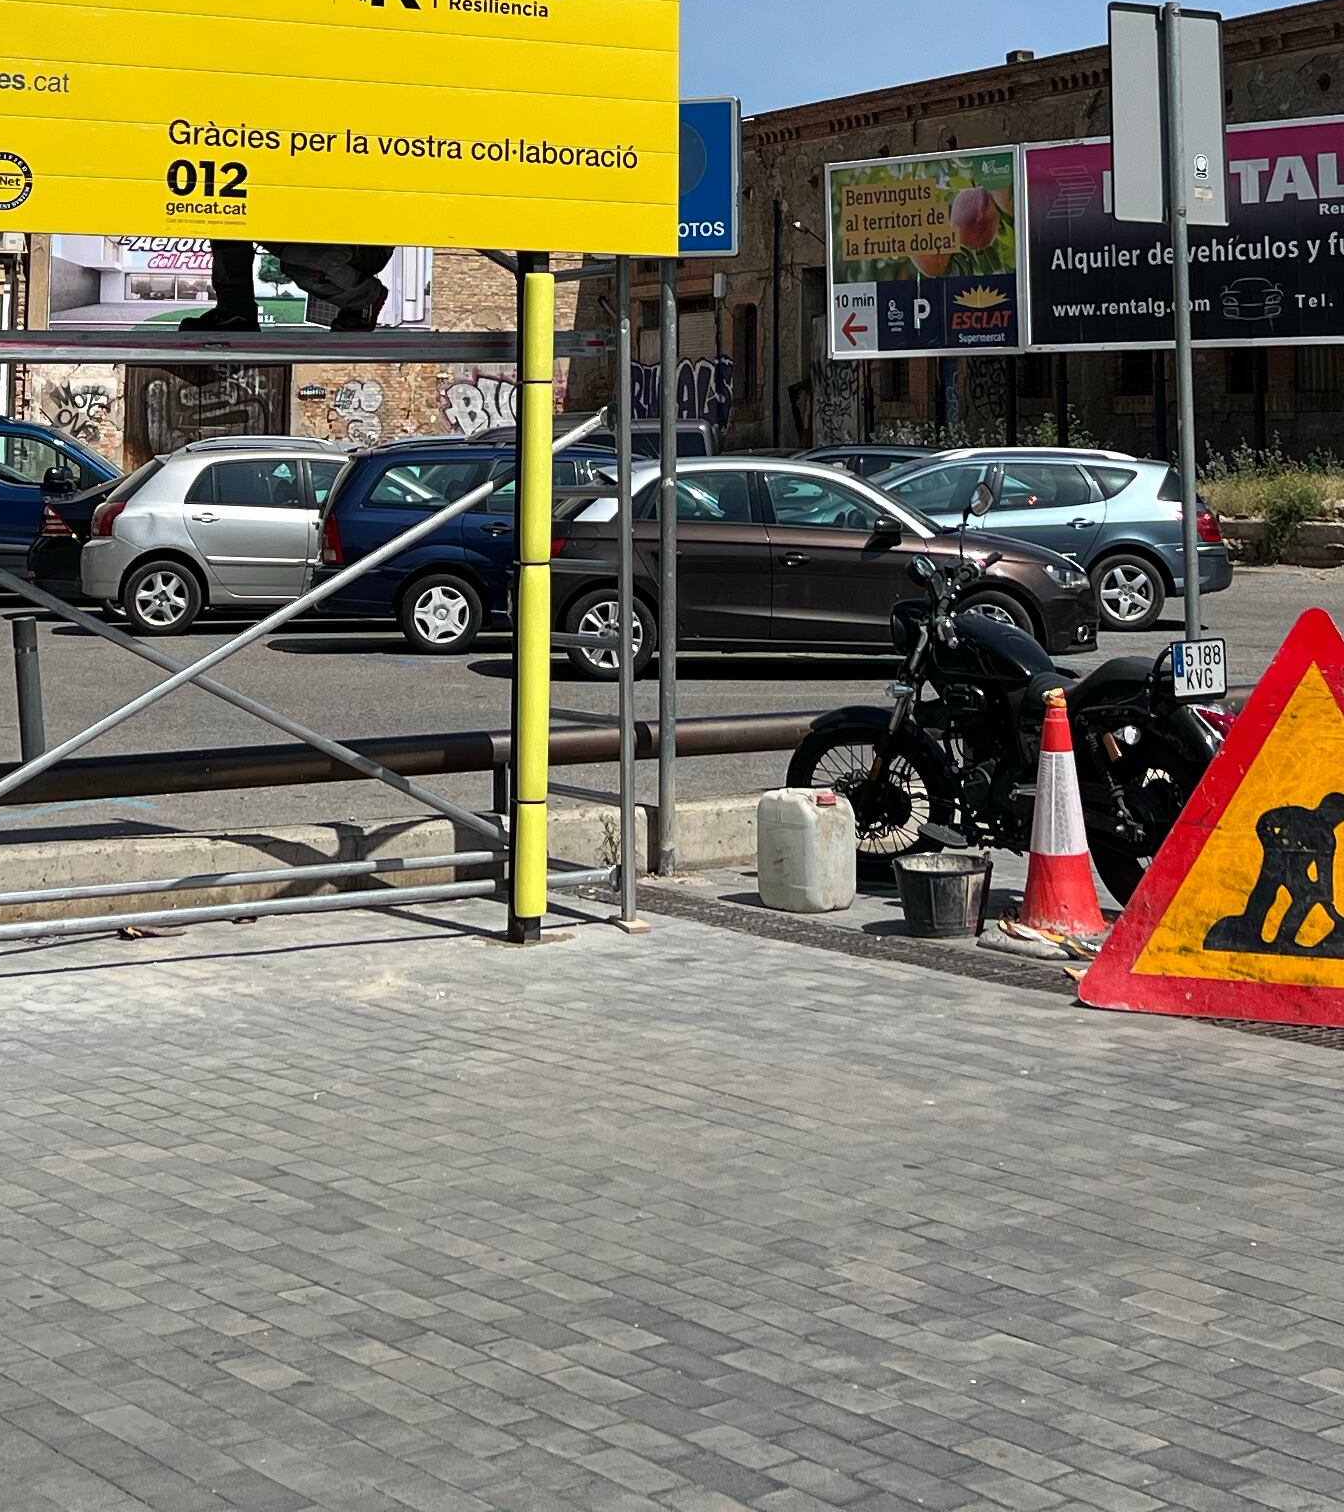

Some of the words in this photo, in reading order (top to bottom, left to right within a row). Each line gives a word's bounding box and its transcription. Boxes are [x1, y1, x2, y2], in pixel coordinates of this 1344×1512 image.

[168, 119, 281, 149] Gràcies
[289, 130, 337, 157] per
[345, 129, 369, 155] la
[377, 136, 463, 160] vostra
[166, 159, 248, 198] 012
[845, 185, 931, 206] Benvinguts
[165, 201, 247, 215] gencat.cat
[678, 220, 725, 238] OTOS
[846, 215, 859, 232] al
[862, 209, 922, 231] territori
[926, 208, 945, 225] de
[846, 239, 860, 257] la
[863, 236, 906, 254] fruita
[910, 232, 956, 255] dolça!
[1051, 243, 1141, 274] Alquiler
[1147, 241, 1174, 265] de
[1187, 229, 1299, 263] vehículos
[1306, 236, 1321, 262] y
[835, 294, 849, 309] 10
[852, 292, 875, 307] min
[1295, 293, 1334, 309] Tel.
[913, 298, 931, 329] P
[951, 310, 1012, 329] ESCLAT
[958, 332, 1005, 344] Supermercat
[1185, 644, 1221, 667] 5188
[1187, 668, 1213, 690] KVG
